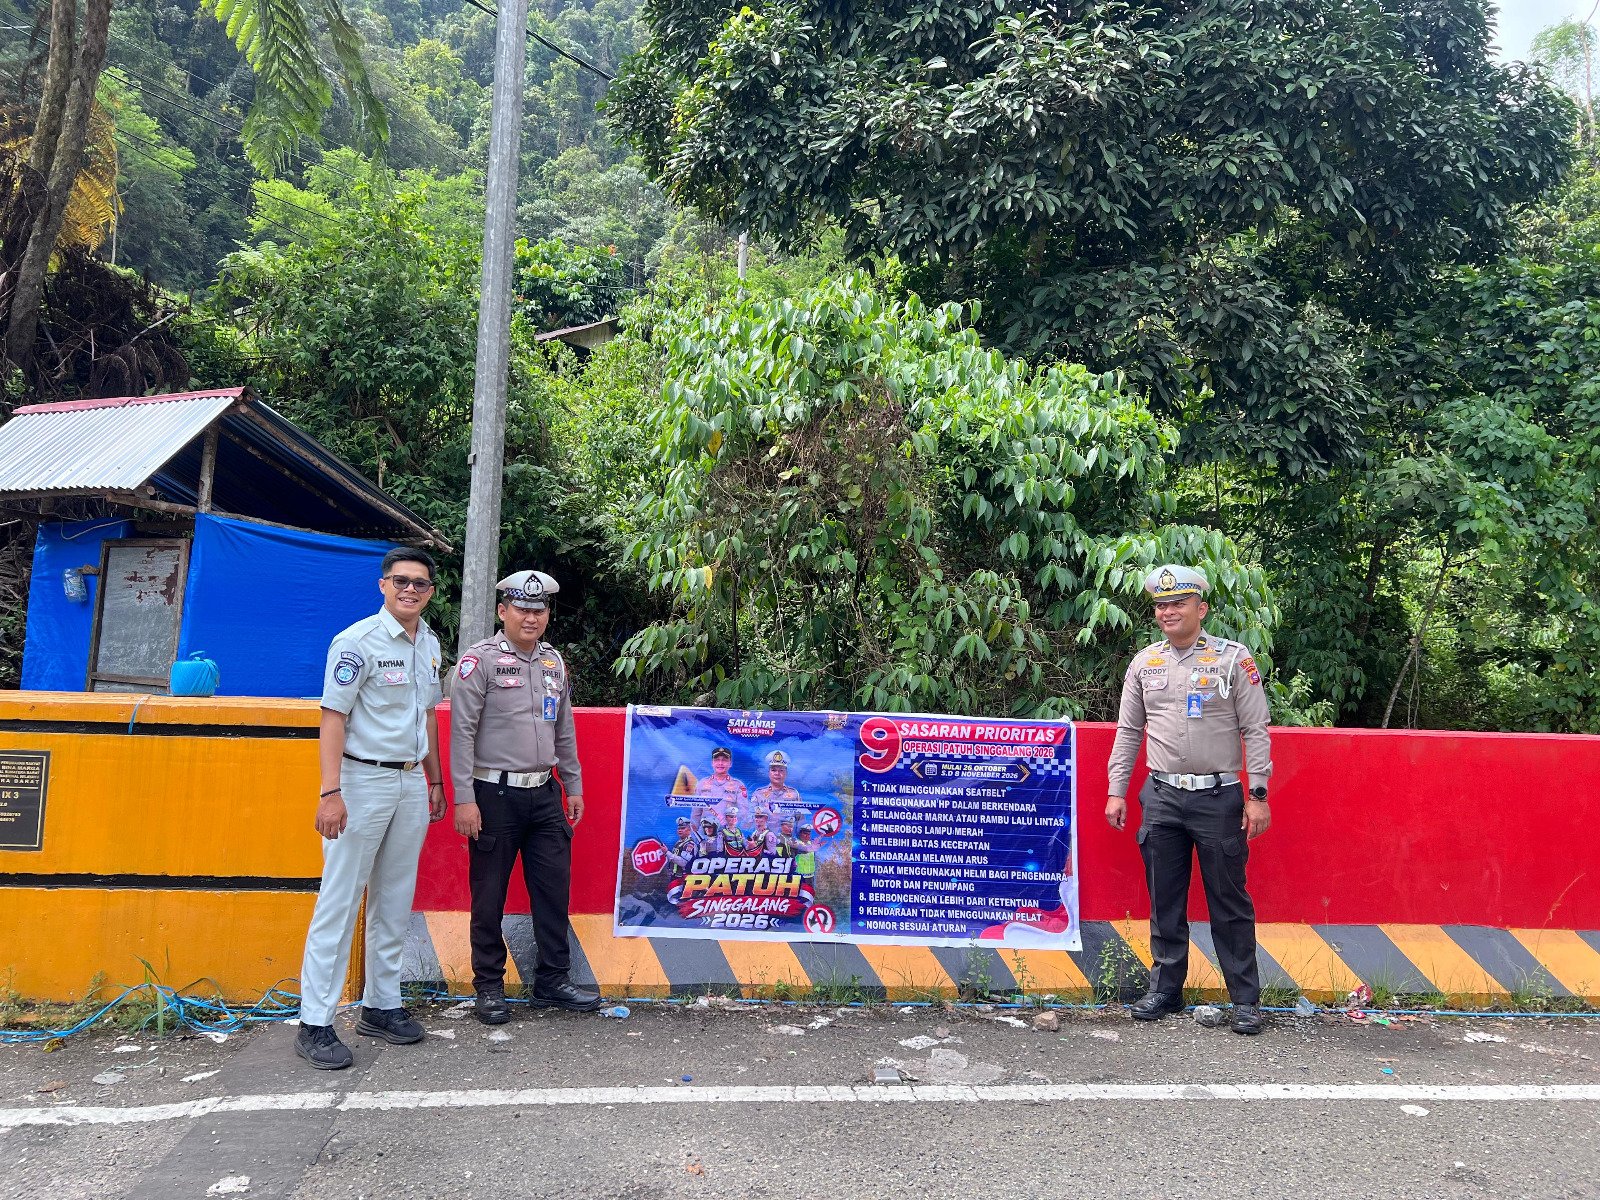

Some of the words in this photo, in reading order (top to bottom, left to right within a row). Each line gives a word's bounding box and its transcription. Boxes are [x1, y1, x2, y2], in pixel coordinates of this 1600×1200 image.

[378, 660, 405, 668] RAYHAN
[542, 669, 560, 678] POLRI
[727, 719, 776, 729] SATLANTAS
[859, 717, 901, 773] 9
[901, 723, 970, 739] SASARAN
[975, 727, 1055, 742] PRIORITAS
[903, 741, 942, 754] OPERASI
[943, 742, 973, 755] PATUH
[974, 744, 1032, 757] SINGGALANG
[1032, 747, 1054, 758] 2026
[872, 784, 897, 793] TIDAK
[899, 785, 964, 796] MENGGUNAKAN
[966, 788, 1006, 798] SEATBELT
[872, 797, 936, 808] MENGGUNAKAN
[939, 800, 950, 809] HP
[952, 801, 979, 810] DALAM
[982, 802, 1036, 812] BERKENDARA
[872, 811, 923, 821] MELANGGAR
[925, 813, 954, 822] MARKA
[956, 814, 977, 823] ATAU
[980, 815, 1009, 824] RAMBU
[1012, 816, 1032, 825] LALU
[1035, 817, 1065, 827] LINTAS
[862, 824, 869, 832] 4.
[871, 824, 922, 834] MENEROBOS
[924, 826, 952, 835] LAMPU
[954, 827, 984, 836] MERAH
[871, 837, 909, 847] MELEBIHI
[912, 839, 938, 848] BATAS
[941, 841, 990, 851] KECEPATAN
[634, 849, 664, 867] STOP
[860, 851, 868, 859] 6.
[869, 851, 920, 862] KENDARAAN
[922, 854, 963, 864] MELAWAN
[966, 856, 988, 864] ARUS
[691, 857, 794, 874] OPERASI
[860, 865, 868, 873] 7.
[870, 865, 894, 875] TIDAK
[897, 866, 962, 877] MENGGUNAKAN
[964, 869, 986, 878] HELM
[989, 870, 1008, 879] BAGI
[1011, 871, 1068, 882] PENGENDARA
[681, 874, 801, 899] PATUH
[872, 879, 901, 888] MOTOR
[903, 881, 920, 889] DAN
[922, 881, 975, 892] PENUMPANG
[685, 897, 790, 918] SINGGALANG
[859, 893, 867, 901] 8.
[869, 893, 937, 903] BERBONCENGAN
[939, 895, 964, 904] LEBIH
[966, 897, 986, 906] DARI
[988, 898, 1039, 908] KETENTUAN
[710, 913, 770, 929] 2026
[859, 906, 864, 915] 9
[866, 906, 917, 917] KENDARAAN
[920, 909, 945, 918] TIDAK
[948, 910, 1013, 921] MENGGUNAKAN
[1015, 912, 1042, 922] PELAT
[866, 921, 897, 930] NOMOR
[899, 922, 929, 931] SESUAI
[932, 923, 966, 932] ATURAN
